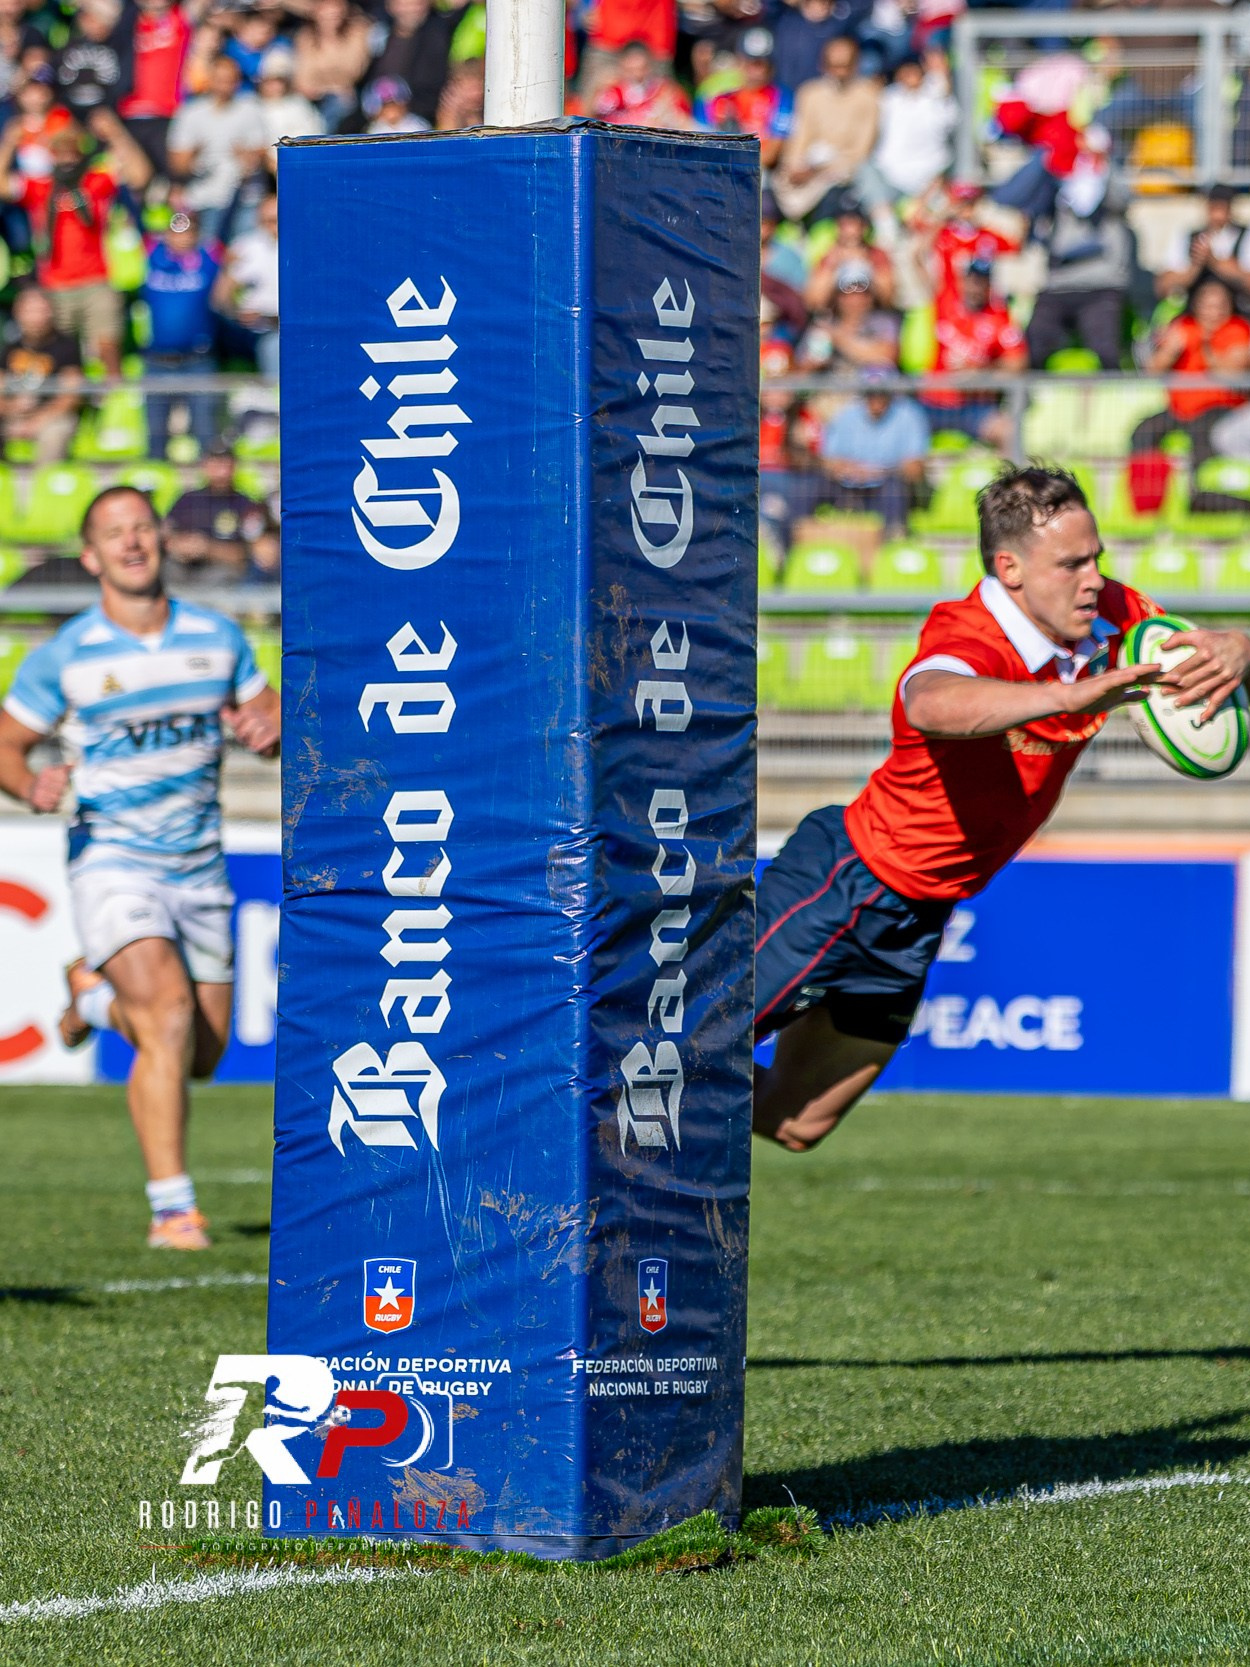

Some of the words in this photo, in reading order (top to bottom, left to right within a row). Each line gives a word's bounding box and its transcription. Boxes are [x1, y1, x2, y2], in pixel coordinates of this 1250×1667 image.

[351, 275, 473, 571] Chile
[630, 276, 701, 569] Chile
[357, 620, 458, 734] de
[634, 619, 693, 732] de
[125, 713, 207, 747] VISA
[327, 790, 455, 1157] Banco
[616, 788, 697, 1158] Banco
[378, 1265, 402, 1274] CHILE
[645, 1266, 660, 1274] CHILE
[374, 1313, 403, 1322] RUGBY
[645, 1314, 662, 1322] RUGBY
[397, 1357, 512, 1374] DEPORTIVA
[572, 1353, 654, 1374] FEDERACIÓN
[656, 1357, 718, 1372] DEPORTIVA
[388, 1380, 415, 1395] DE
[421, 1381, 493, 1397] RUGBY
[589, 1380, 650, 1397] NACIONAL
[654, 1381, 669, 1395] DE
[672, 1380, 709, 1394] RUGBY
